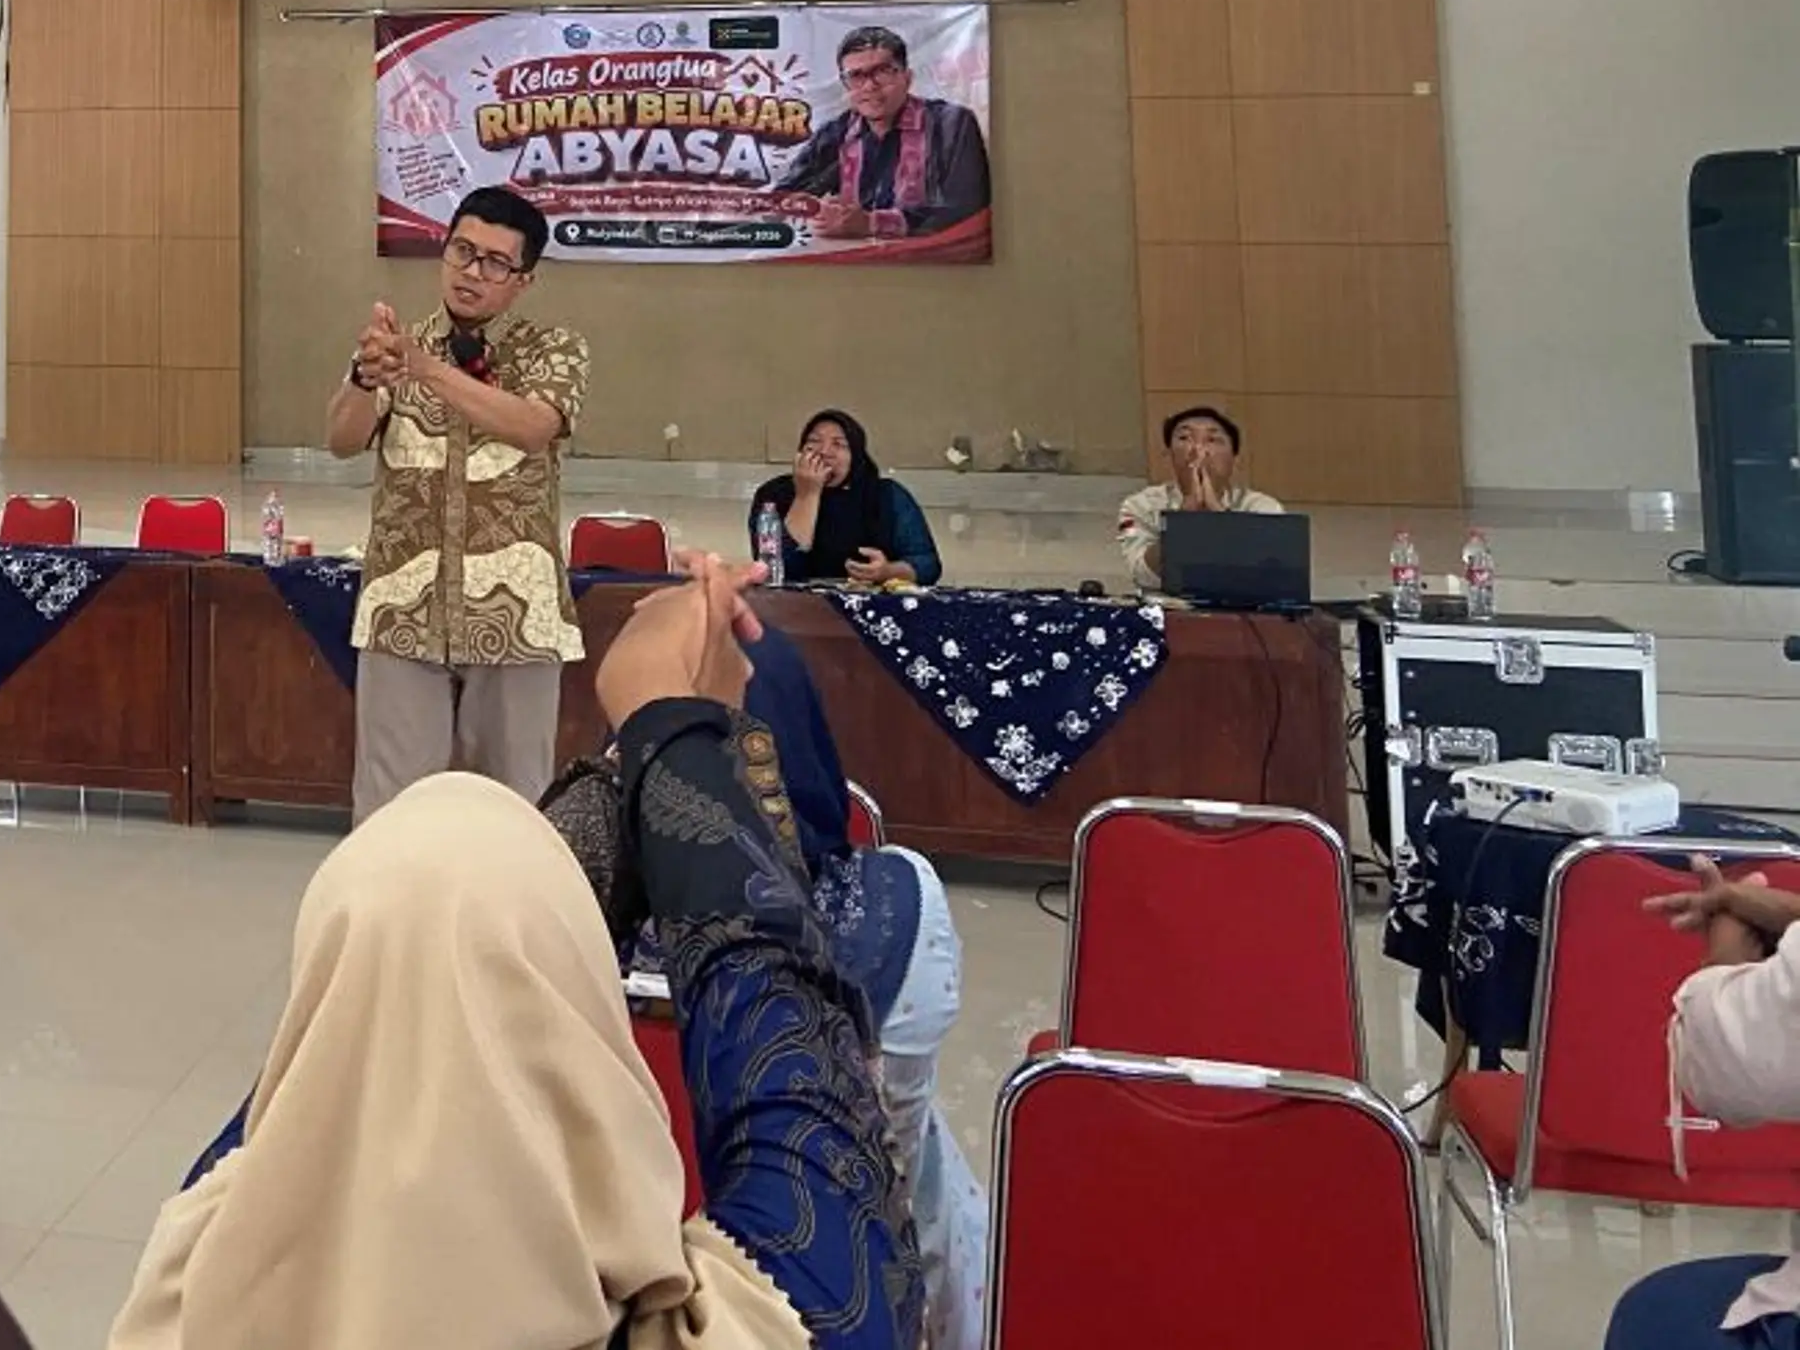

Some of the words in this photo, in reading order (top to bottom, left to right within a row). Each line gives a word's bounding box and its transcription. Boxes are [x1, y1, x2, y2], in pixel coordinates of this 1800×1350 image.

[508, 62, 580, 96] Kelas
[587, 54, 716, 88] Orangtua
[476, 92, 627, 144] RUMAH
[635, 92, 809, 139] BELAJAR
[511, 128, 769, 181] ABYASA
